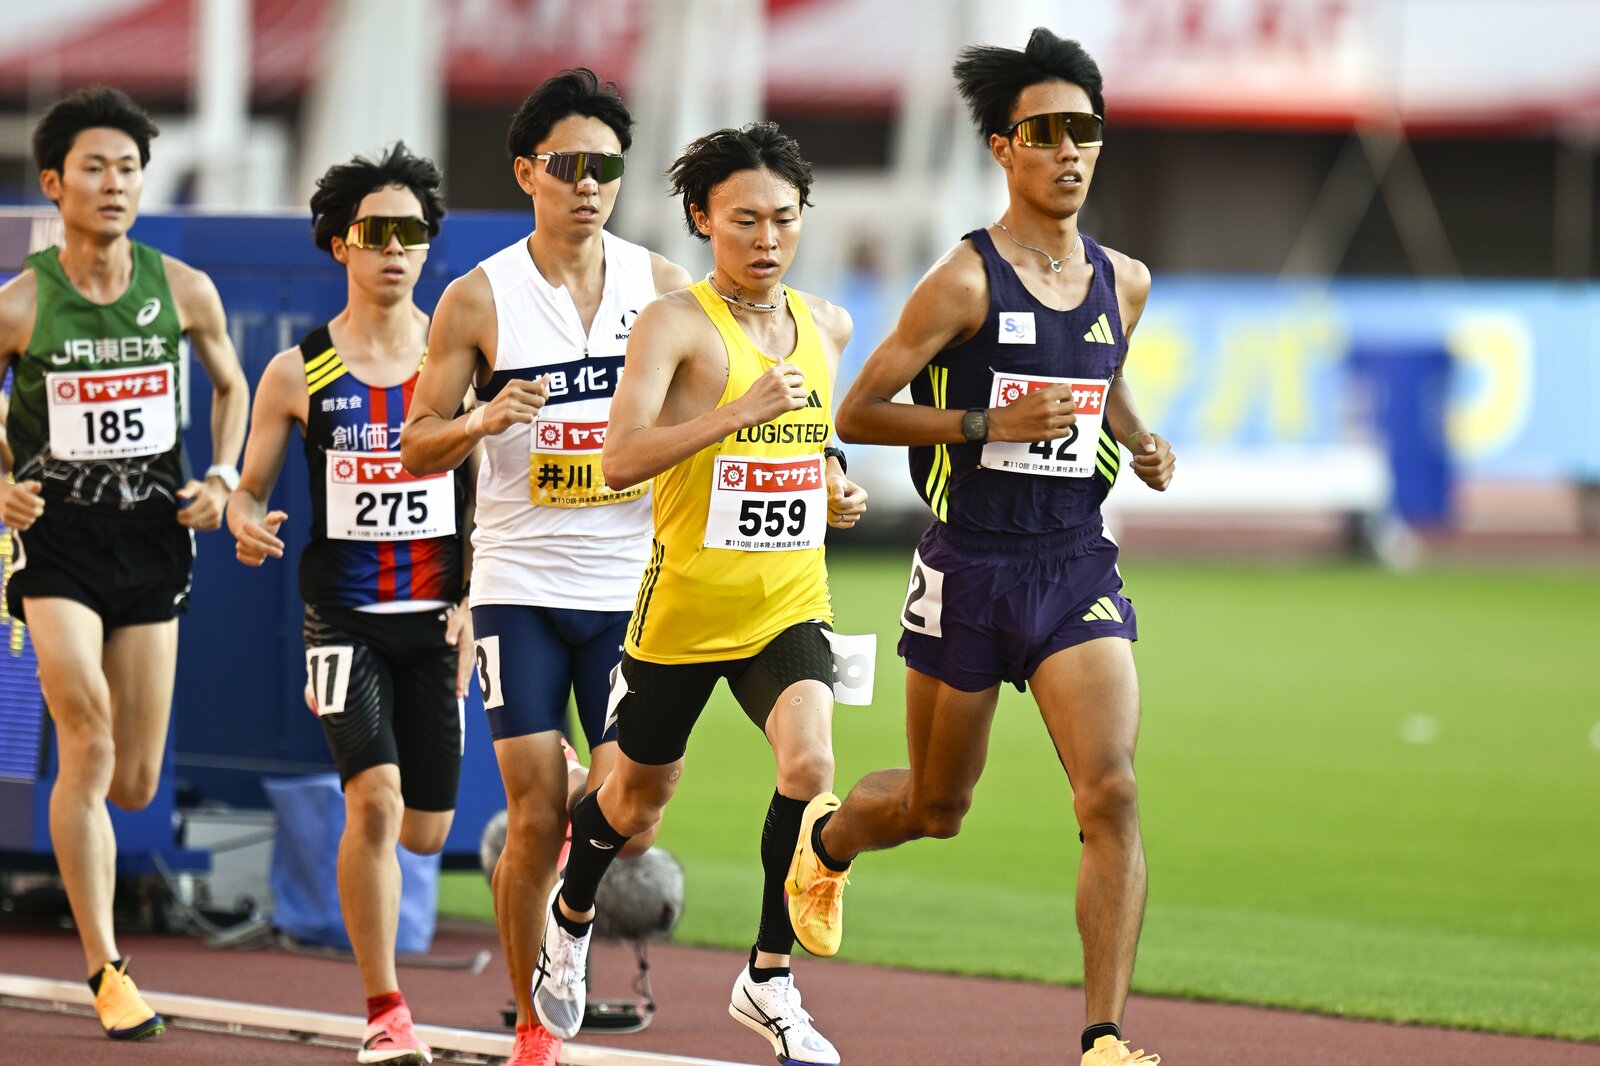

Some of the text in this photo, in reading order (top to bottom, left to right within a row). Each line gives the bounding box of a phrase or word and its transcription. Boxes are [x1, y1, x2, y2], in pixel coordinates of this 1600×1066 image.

[51, 334, 168, 366] JR東日本
[615, 333, 630, 341] Mov
[83, 376, 164, 400] ヤマザキ
[533, 365, 625, 396] 旭化
[321, 394, 363, 413] 創友会
[83, 408, 145, 445] 185
[569, 427, 608, 446] ヤマ
[361, 461, 403, 480] ヤマ
[537, 463, 592, 490] 井川
[752, 465, 819, 487] ヤマザキ
[355, 490, 428, 527] 275
[738, 498, 807, 538] 559
[904, 564, 927, 628] 2
[310, 653, 340, 709] 11
[475, 644, 491, 703] 3
